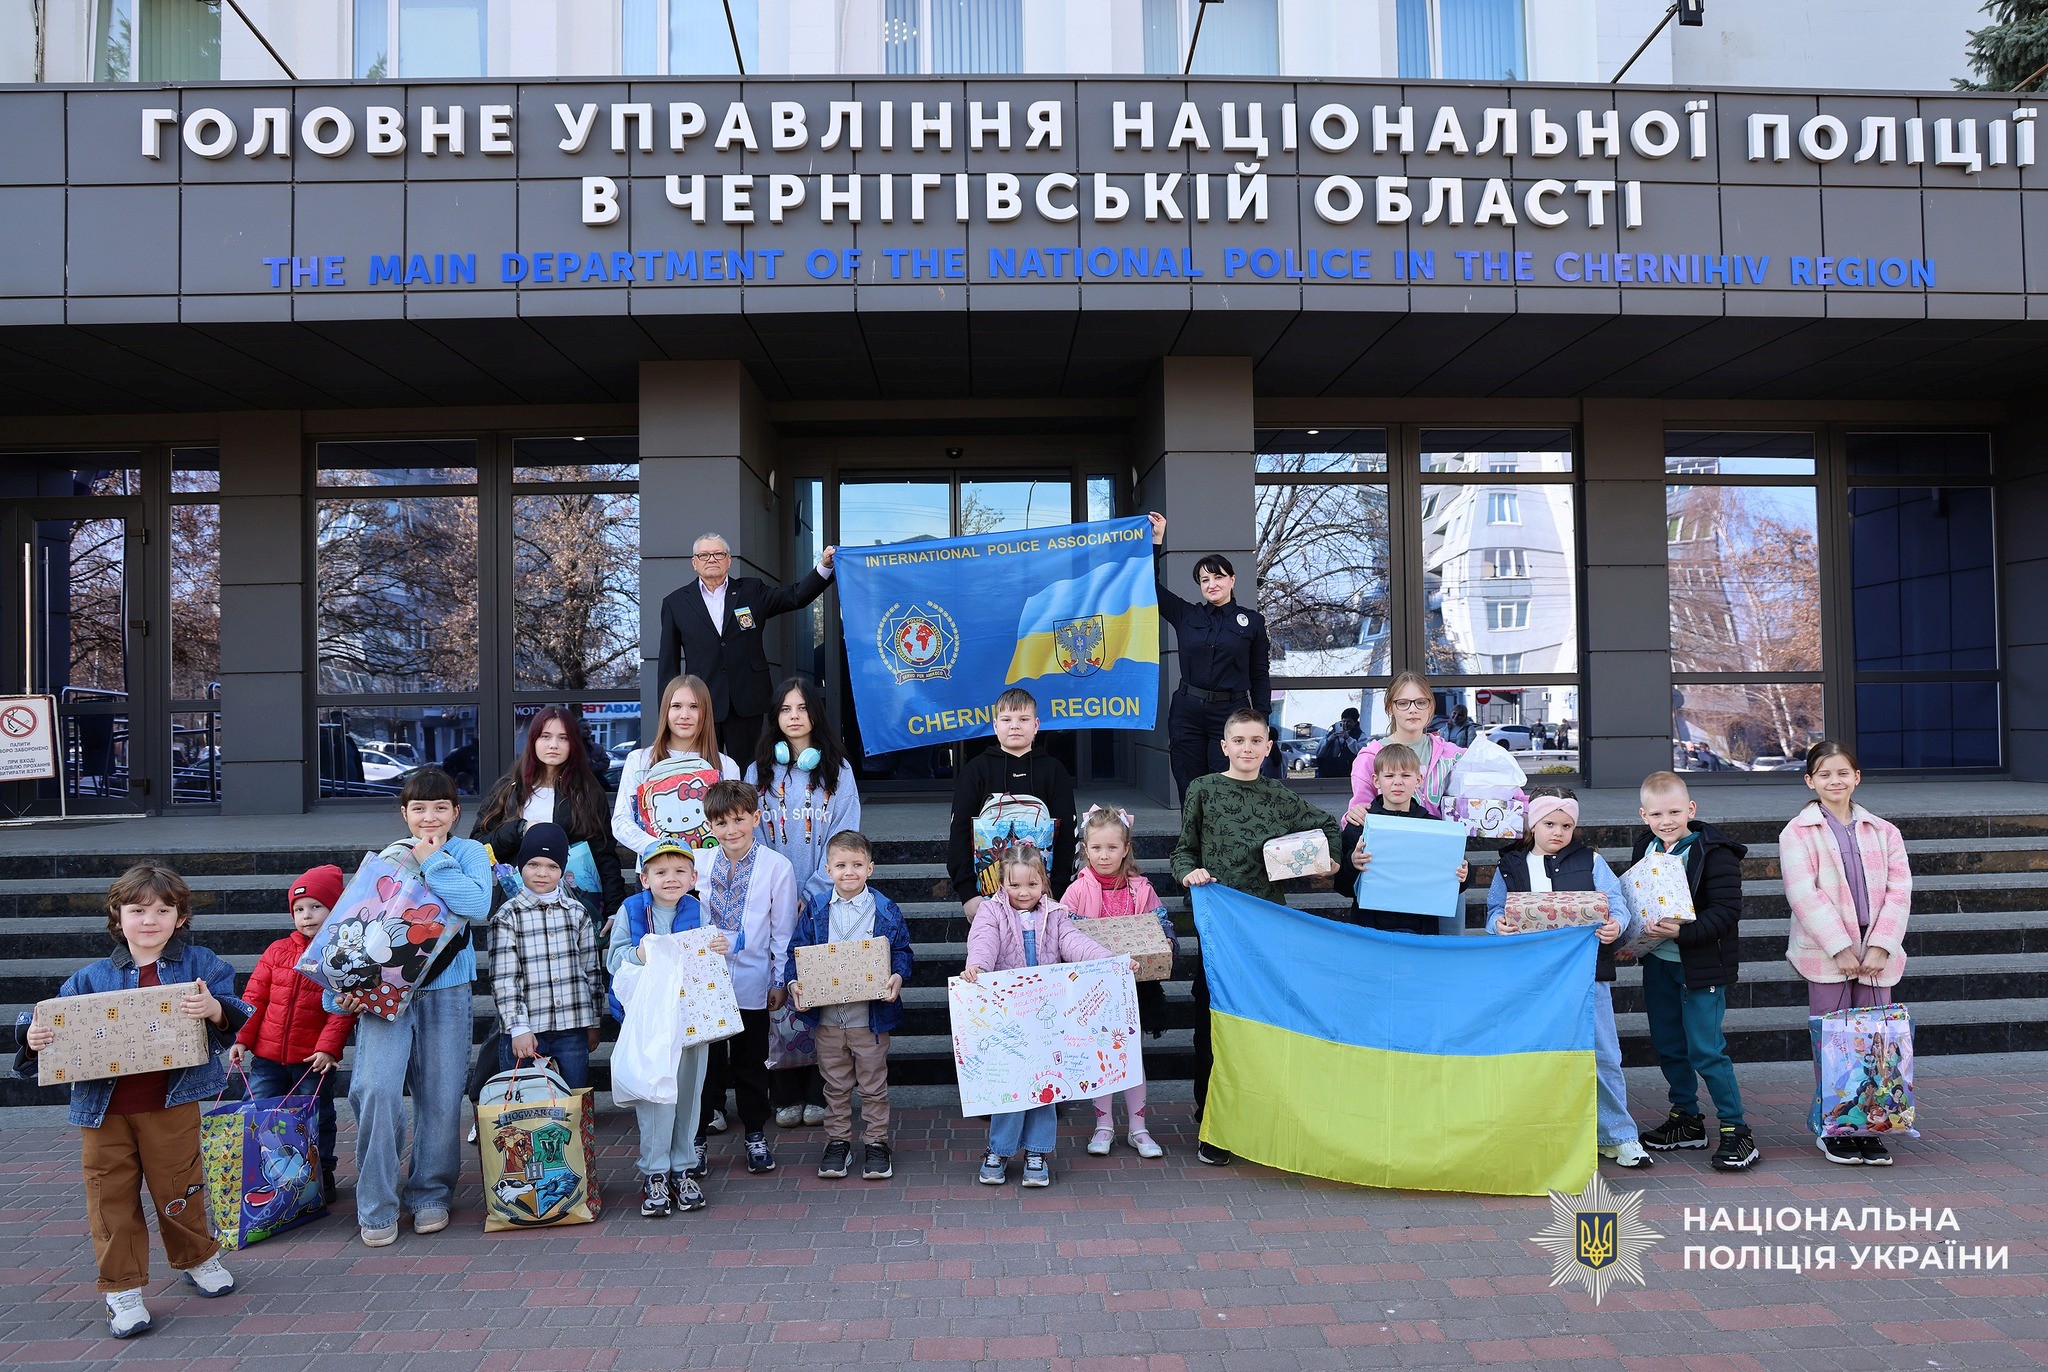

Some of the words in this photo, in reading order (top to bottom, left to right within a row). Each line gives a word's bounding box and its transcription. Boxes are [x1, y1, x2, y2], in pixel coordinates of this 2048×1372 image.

[140, 104, 516, 161] ГОЛОВНЕ
[554, 99, 1063, 155] УПРАВЛІННЯ
[1112, 99, 1710, 161] НАЦІОНАЛЬНОЇ
[1746, 107, 2039, 175] ПОЛІЦІЇ
[580, 176, 621, 227] В
[664, 161, 1270, 225] ЧЕРНІГІВСЬКІЙ
[1313, 174, 1643, 230] ОБЛАСТІ
[263, 256, 345, 288] THE
[369, 252, 476, 285] MAIN
[501, 248, 785, 284] DEPARTMENT
[805, 248, 861, 279] OF
[883, 248, 966, 279] THE
[988, 246, 1203, 279] NATIONAL
[1224, 248, 1371, 280] POLICE
[1394, 249, 1436, 281] IN
[1454, 250, 1536, 282] THE
[1554, 250, 1771, 285] CHERNIHIV
[1790, 255, 1937, 288] REGION
[865, 544, 981, 568] INTERNATIONAL
[987, 540, 1040, 557] POLICE
[1047, 527, 1144, 550] ASSOCIATION
[907, 705, 997, 736] CHERNI
[1051, 696, 1141, 718] REGION
[761, 805, 788, 823] on't
[504, 1108, 562, 1122] HOGWARTS
